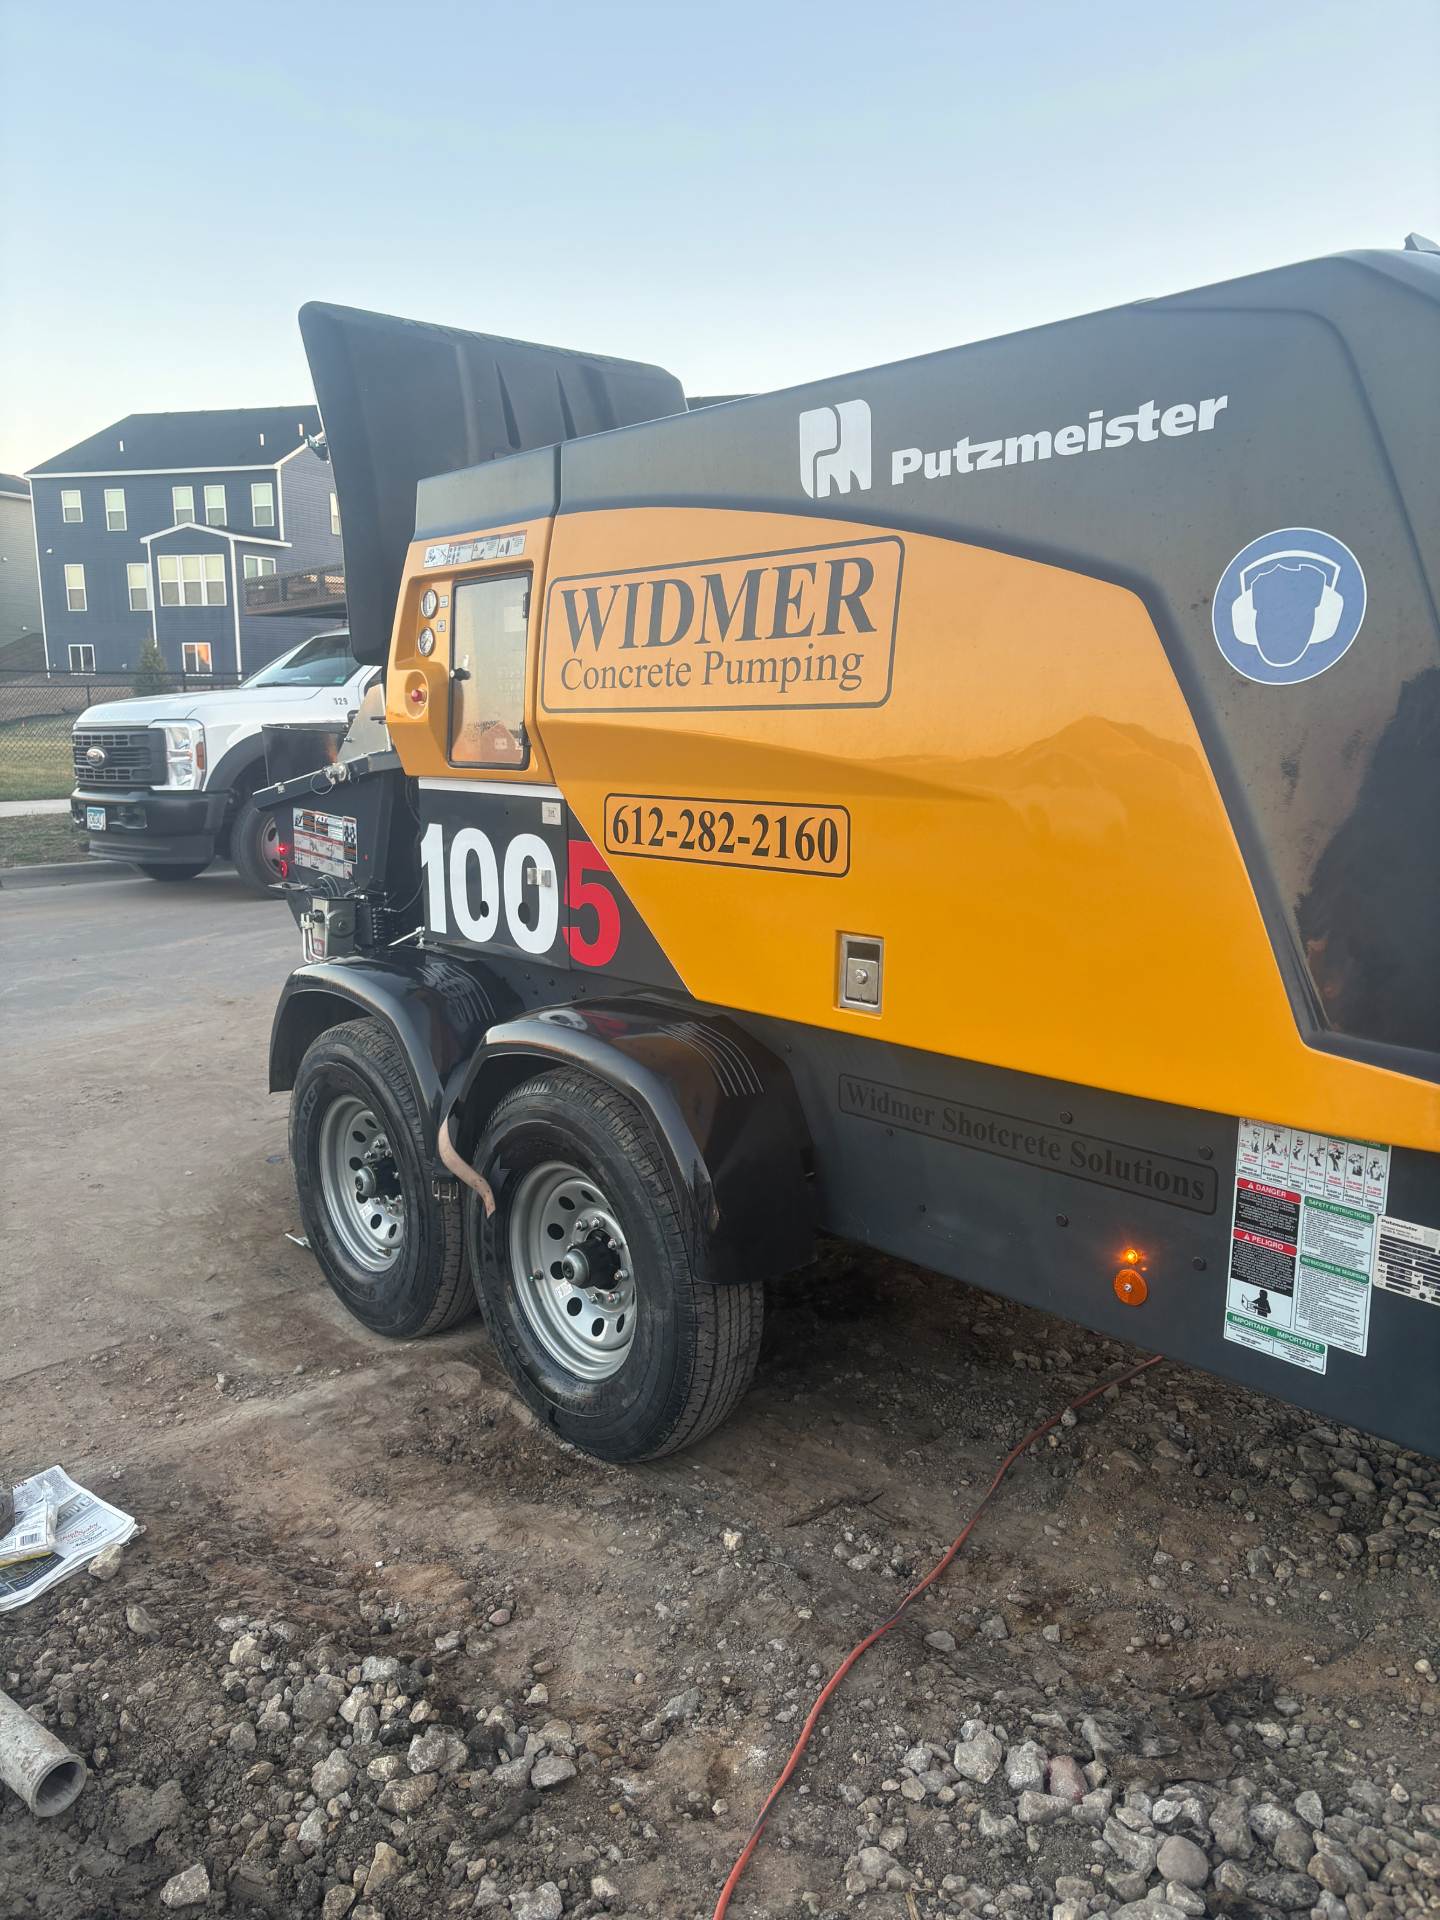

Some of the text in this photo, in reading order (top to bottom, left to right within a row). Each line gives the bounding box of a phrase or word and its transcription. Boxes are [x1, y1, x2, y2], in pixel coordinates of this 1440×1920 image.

[892, 395, 1228, 486] Putzmeister
[561, 557, 877, 654] WIDMER
[561, 643, 865, 693] Concrete Pumping
[612, 805, 838, 864] 612-282-2160
[420, 823, 621, 967] 1005
[846, 1081, 1205, 1202] Widmer Shotcrete Solutions
[1255, 1183, 1286, 1198] DANGER
[1308, 1199, 1328, 1211] SAFETY
[1329, 1204, 1371, 1221] INSTRUCTIONS
[1252, 1235, 1284, 1250] PELIGRO
[1301, 1256, 1334, 1272] INSTRUCCIONES
[1341, 1268, 1367, 1281] SEGURIDAD
[1232, 1315, 1270, 1333] IMPORTANT
[1276, 1330, 1320, 1351] IMPORTANTE
